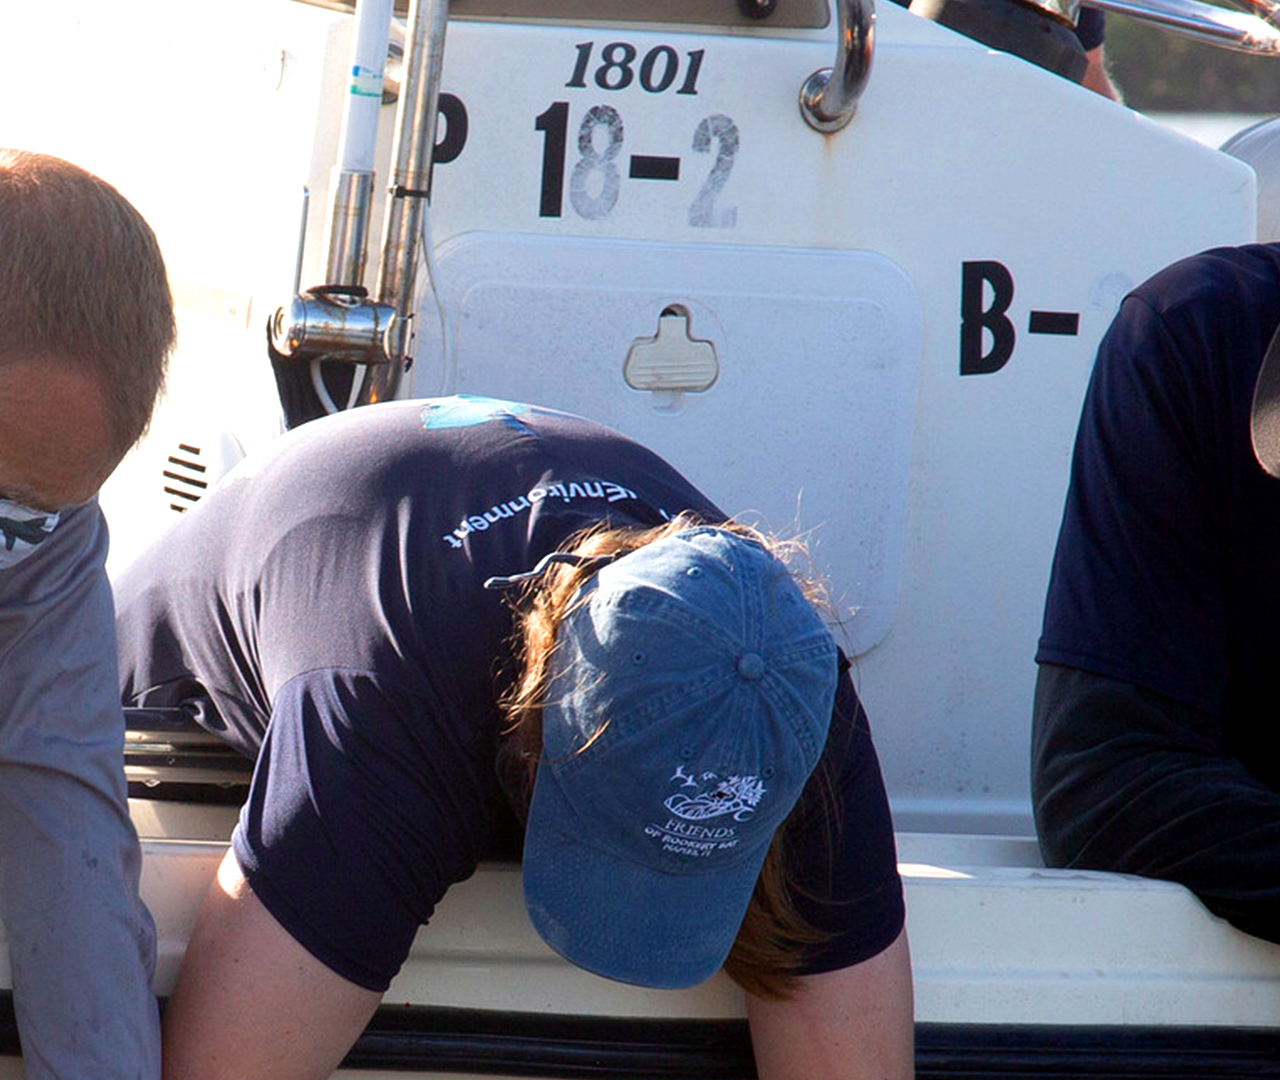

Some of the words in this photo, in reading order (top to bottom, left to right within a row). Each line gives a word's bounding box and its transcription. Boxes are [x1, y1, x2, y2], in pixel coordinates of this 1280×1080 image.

[565, 41, 705, 95] 1801
[535, 101, 740, 229] 18-2
[443, 481, 632, 549] Environment
[644, 826, 661, 838] OF
[664, 818, 736, 838] FRIENDS
